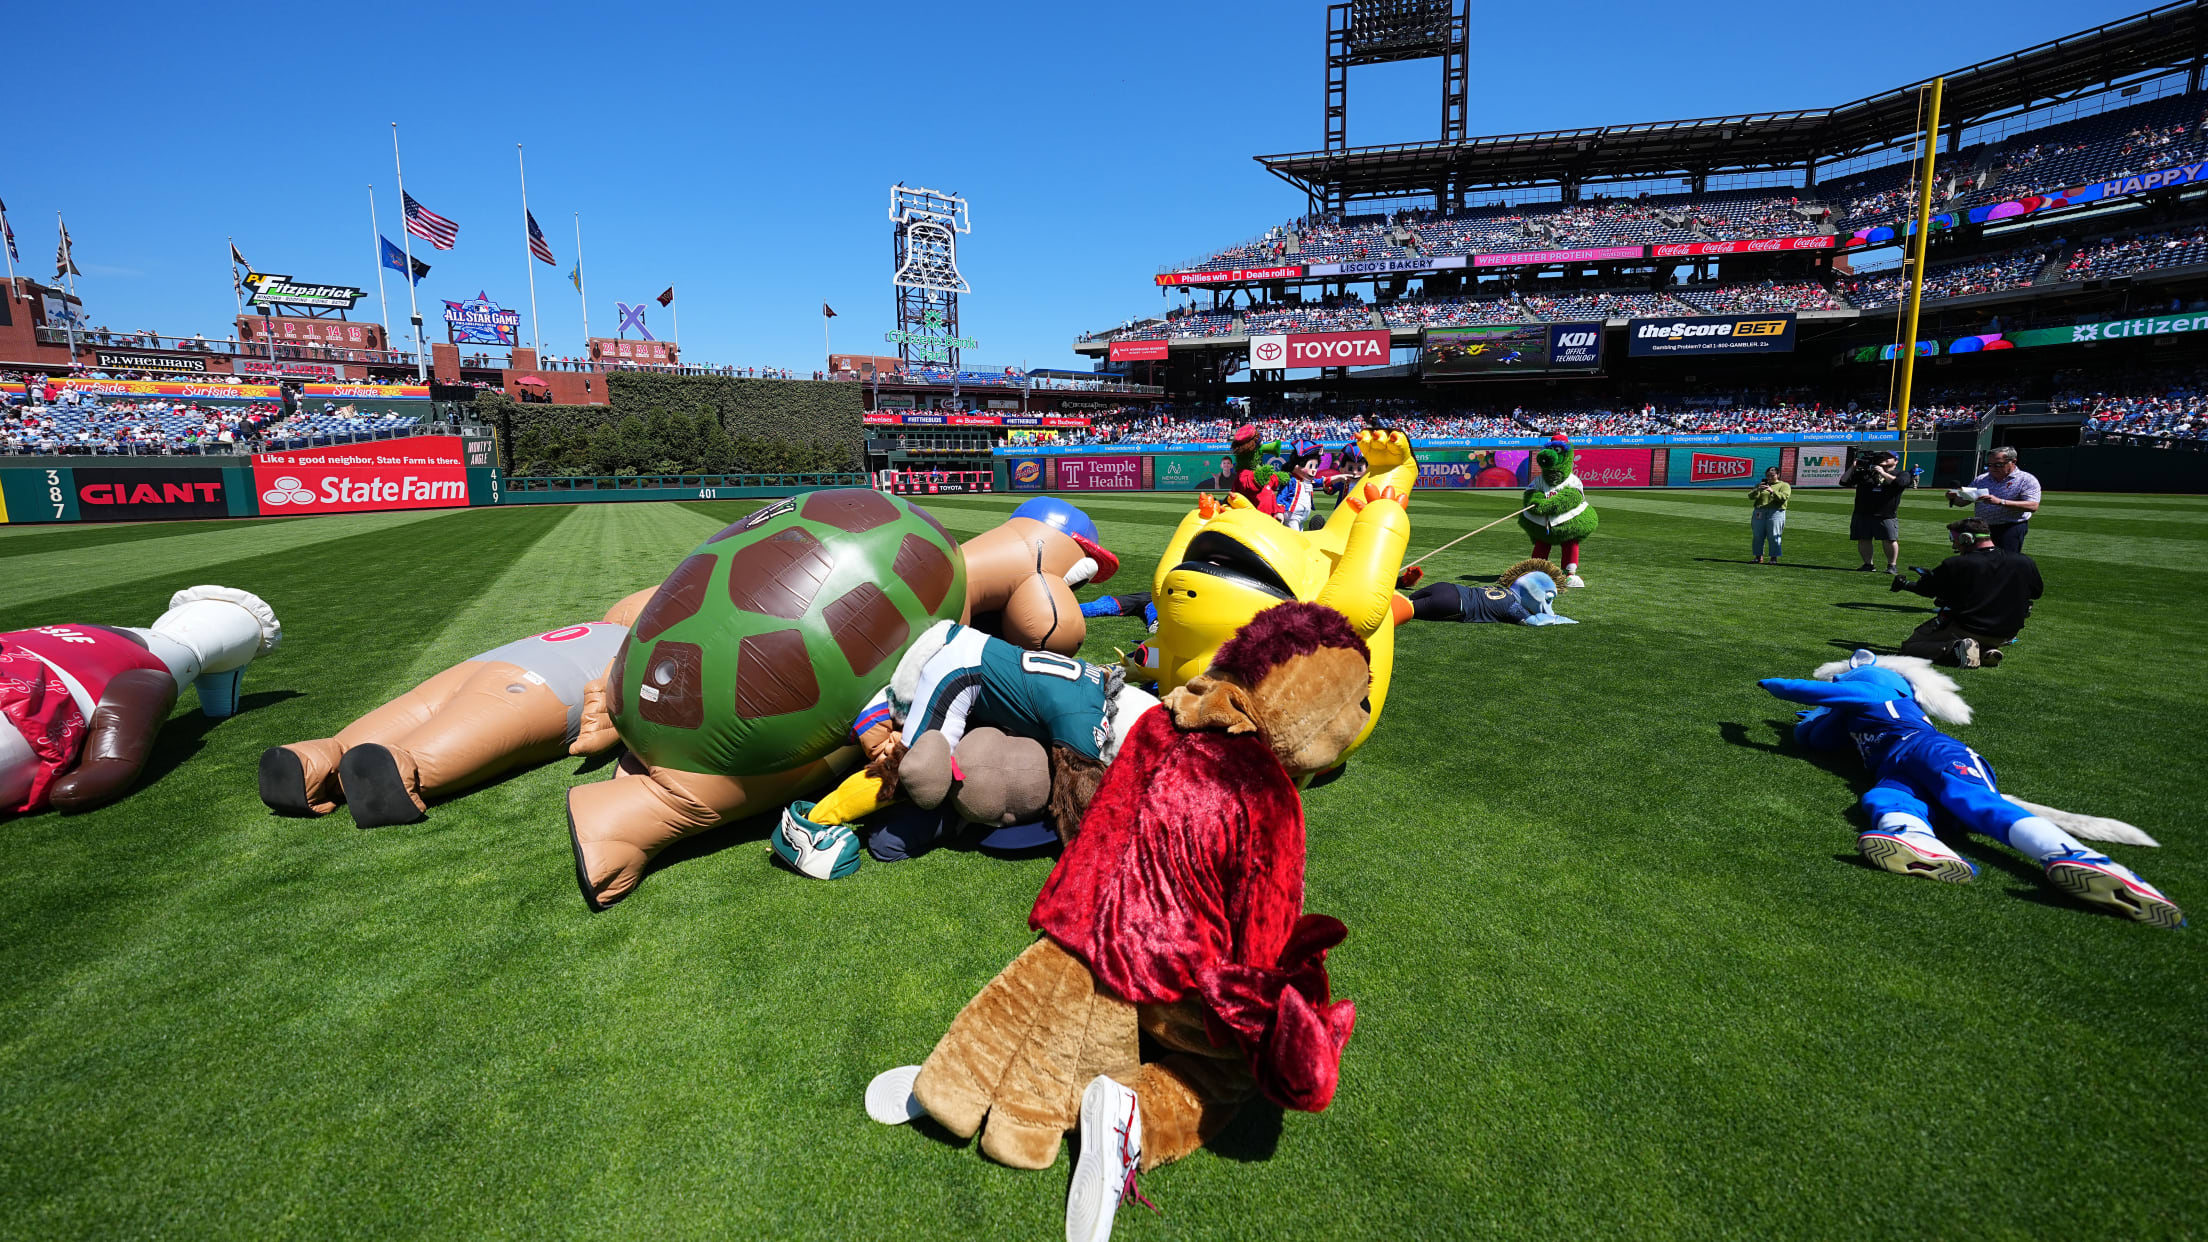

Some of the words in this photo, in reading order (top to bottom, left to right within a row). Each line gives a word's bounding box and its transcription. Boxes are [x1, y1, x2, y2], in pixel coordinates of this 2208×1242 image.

[2102, 164, 2203, 198] HAPPY
[1479, 255, 1509, 264] WHEY
[1511, 253, 1547, 263] BETTER
[1549, 251, 1593, 261] PROTEIN
[1340, 262, 1386, 273] LISCIO'S
[1389, 259, 1434, 270] BAKERY
[246, 274, 267, 284] PJ
[1181, 274, 1211, 283] Phillies
[1212, 273, 1228, 281] win
[1246, 270, 1269, 279] Deals
[1271, 269, 1285, 277] roll
[1286, 268, 1295, 276] in
[253, 275, 354, 299] Fitzpatrick
[491, 312, 520, 326] GAME
[327, 325, 340, 337] 14
[348, 327, 361, 338] 15
[1637, 323, 1732, 338] theScore
[1737, 322, 1782, 335] BET
[888, 330, 942, 346] Citizens
[944, 334, 977, 349] Bank
[1557, 331, 1597, 347] KDI
[919, 348, 949, 362] Park
[1292, 339, 1382, 359] TOYOTA
[1565, 347, 1588, 355] OFFICE
[1555, 354, 1597, 363] TECHNOLOGY
[243, 361, 283, 372] TONY
[62, 379, 126, 394] Surfside
[182, 384, 239, 397] Surfside
[333, 385, 378, 397] Surfside
[260, 454, 285, 464] Like
[288, 456, 295, 464] a
[299, 455, 325, 466] good
[328, 455, 375, 466] neighbor,
[377, 455, 401, 465] State
[403, 456, 426, 465] Farm
[427, 456, 435, 465] is
[436, 456, 461, 465] there.
[1695, 458, 1748, 475] HERR'S
[1803, 456, 1840, 467] WM
[1087, 460, 1136, 474] Temple
[1419, 464, 1470, 476] THDAY
[1089, 475, 1133, 488] Health
[79, 482, 222, 505] GIANT
[699, 488, 716, 499] 401
